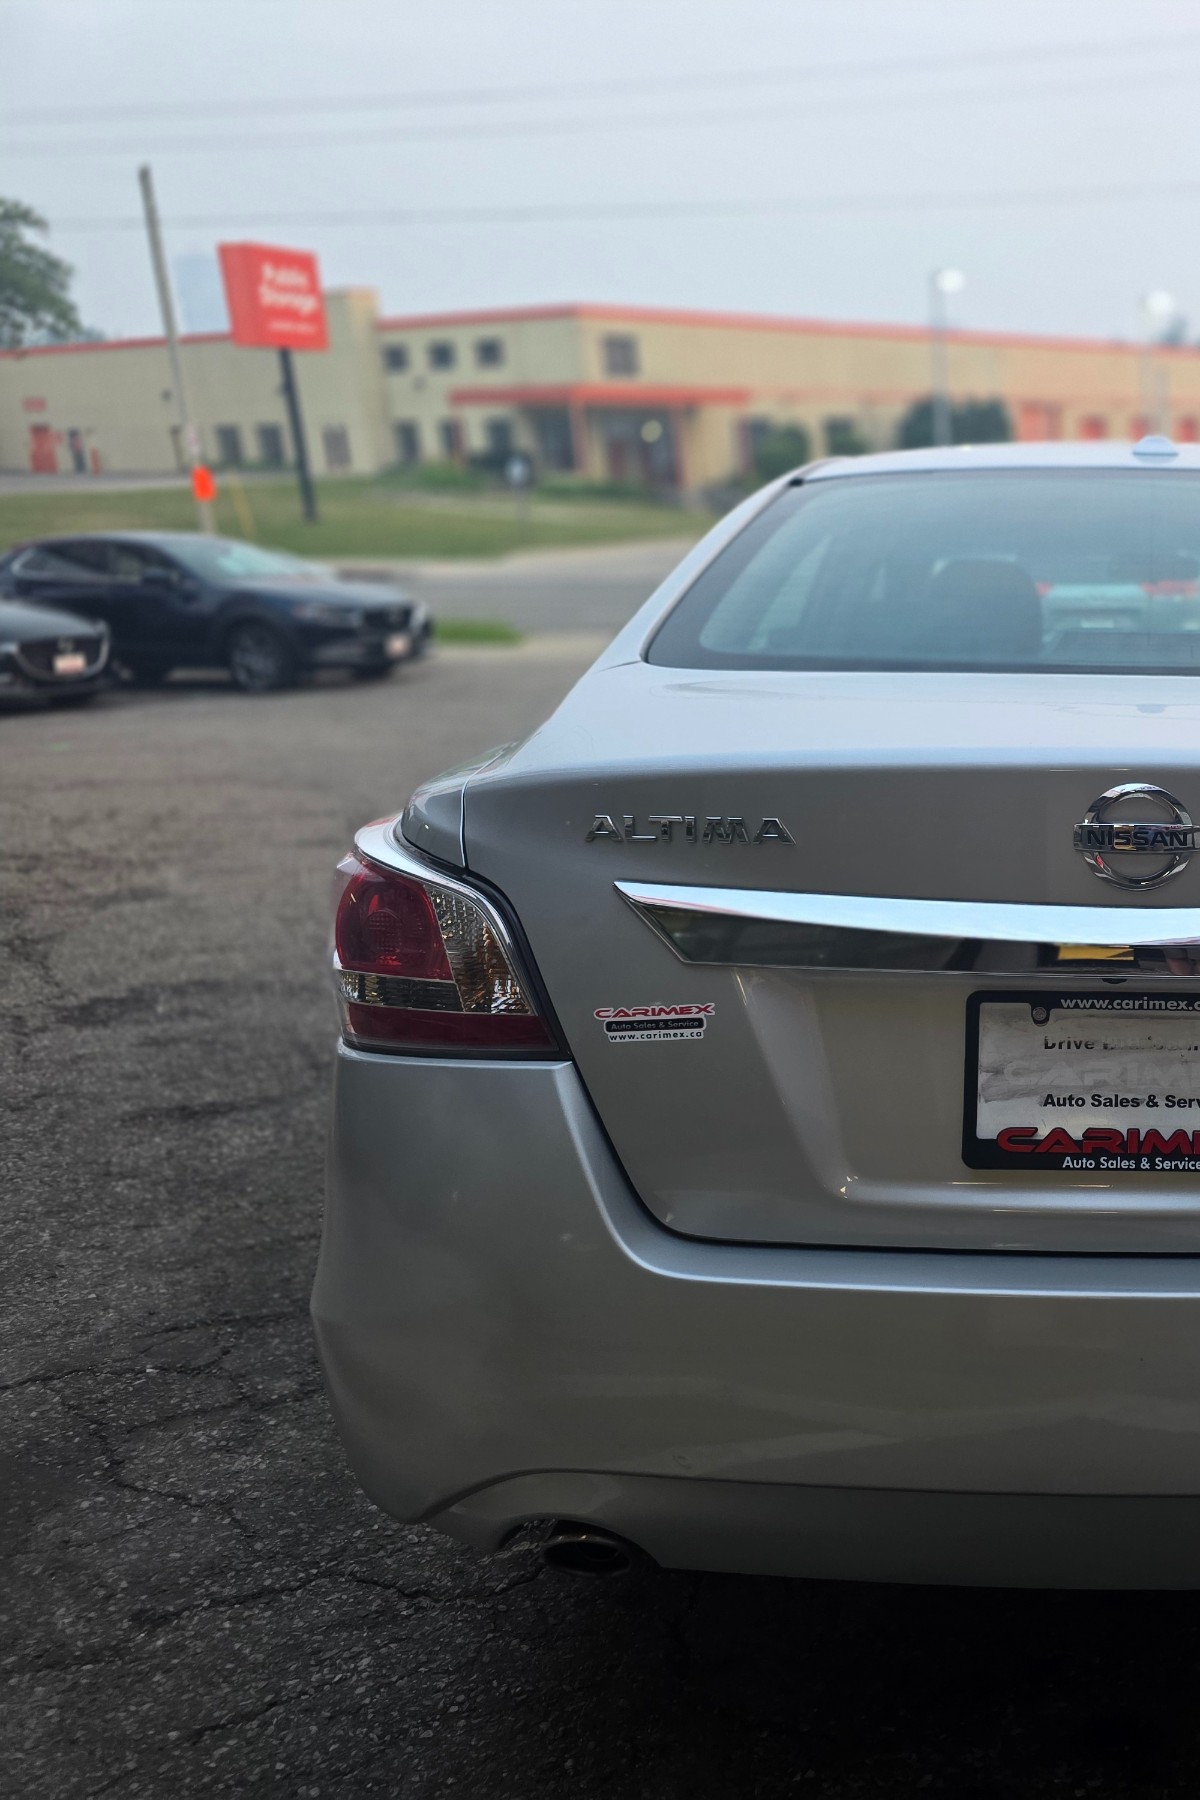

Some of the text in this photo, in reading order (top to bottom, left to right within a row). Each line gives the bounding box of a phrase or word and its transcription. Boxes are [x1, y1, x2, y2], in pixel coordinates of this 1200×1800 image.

[585, 815, 796, 844] ALTIMA
[1087, 830, 1188, 846] NISSAN
[595, 1004, 714, 1018] CARIMEX
[611, 1020, 699, 1031] Auto Sales & Service
[609, 1030, 702, 1041] www.carimex.ca
[1043, 1094, 1086, 1108] Auto
[1091, 1094, 1140, 1108] Sales
[1146, 1095, 1159, 1108] &
[1062, 1156, 1096, 1169] Auto
[1100, 1157, 1136, 1169] Sales
[1140, 1157, 1150, 1169] &
